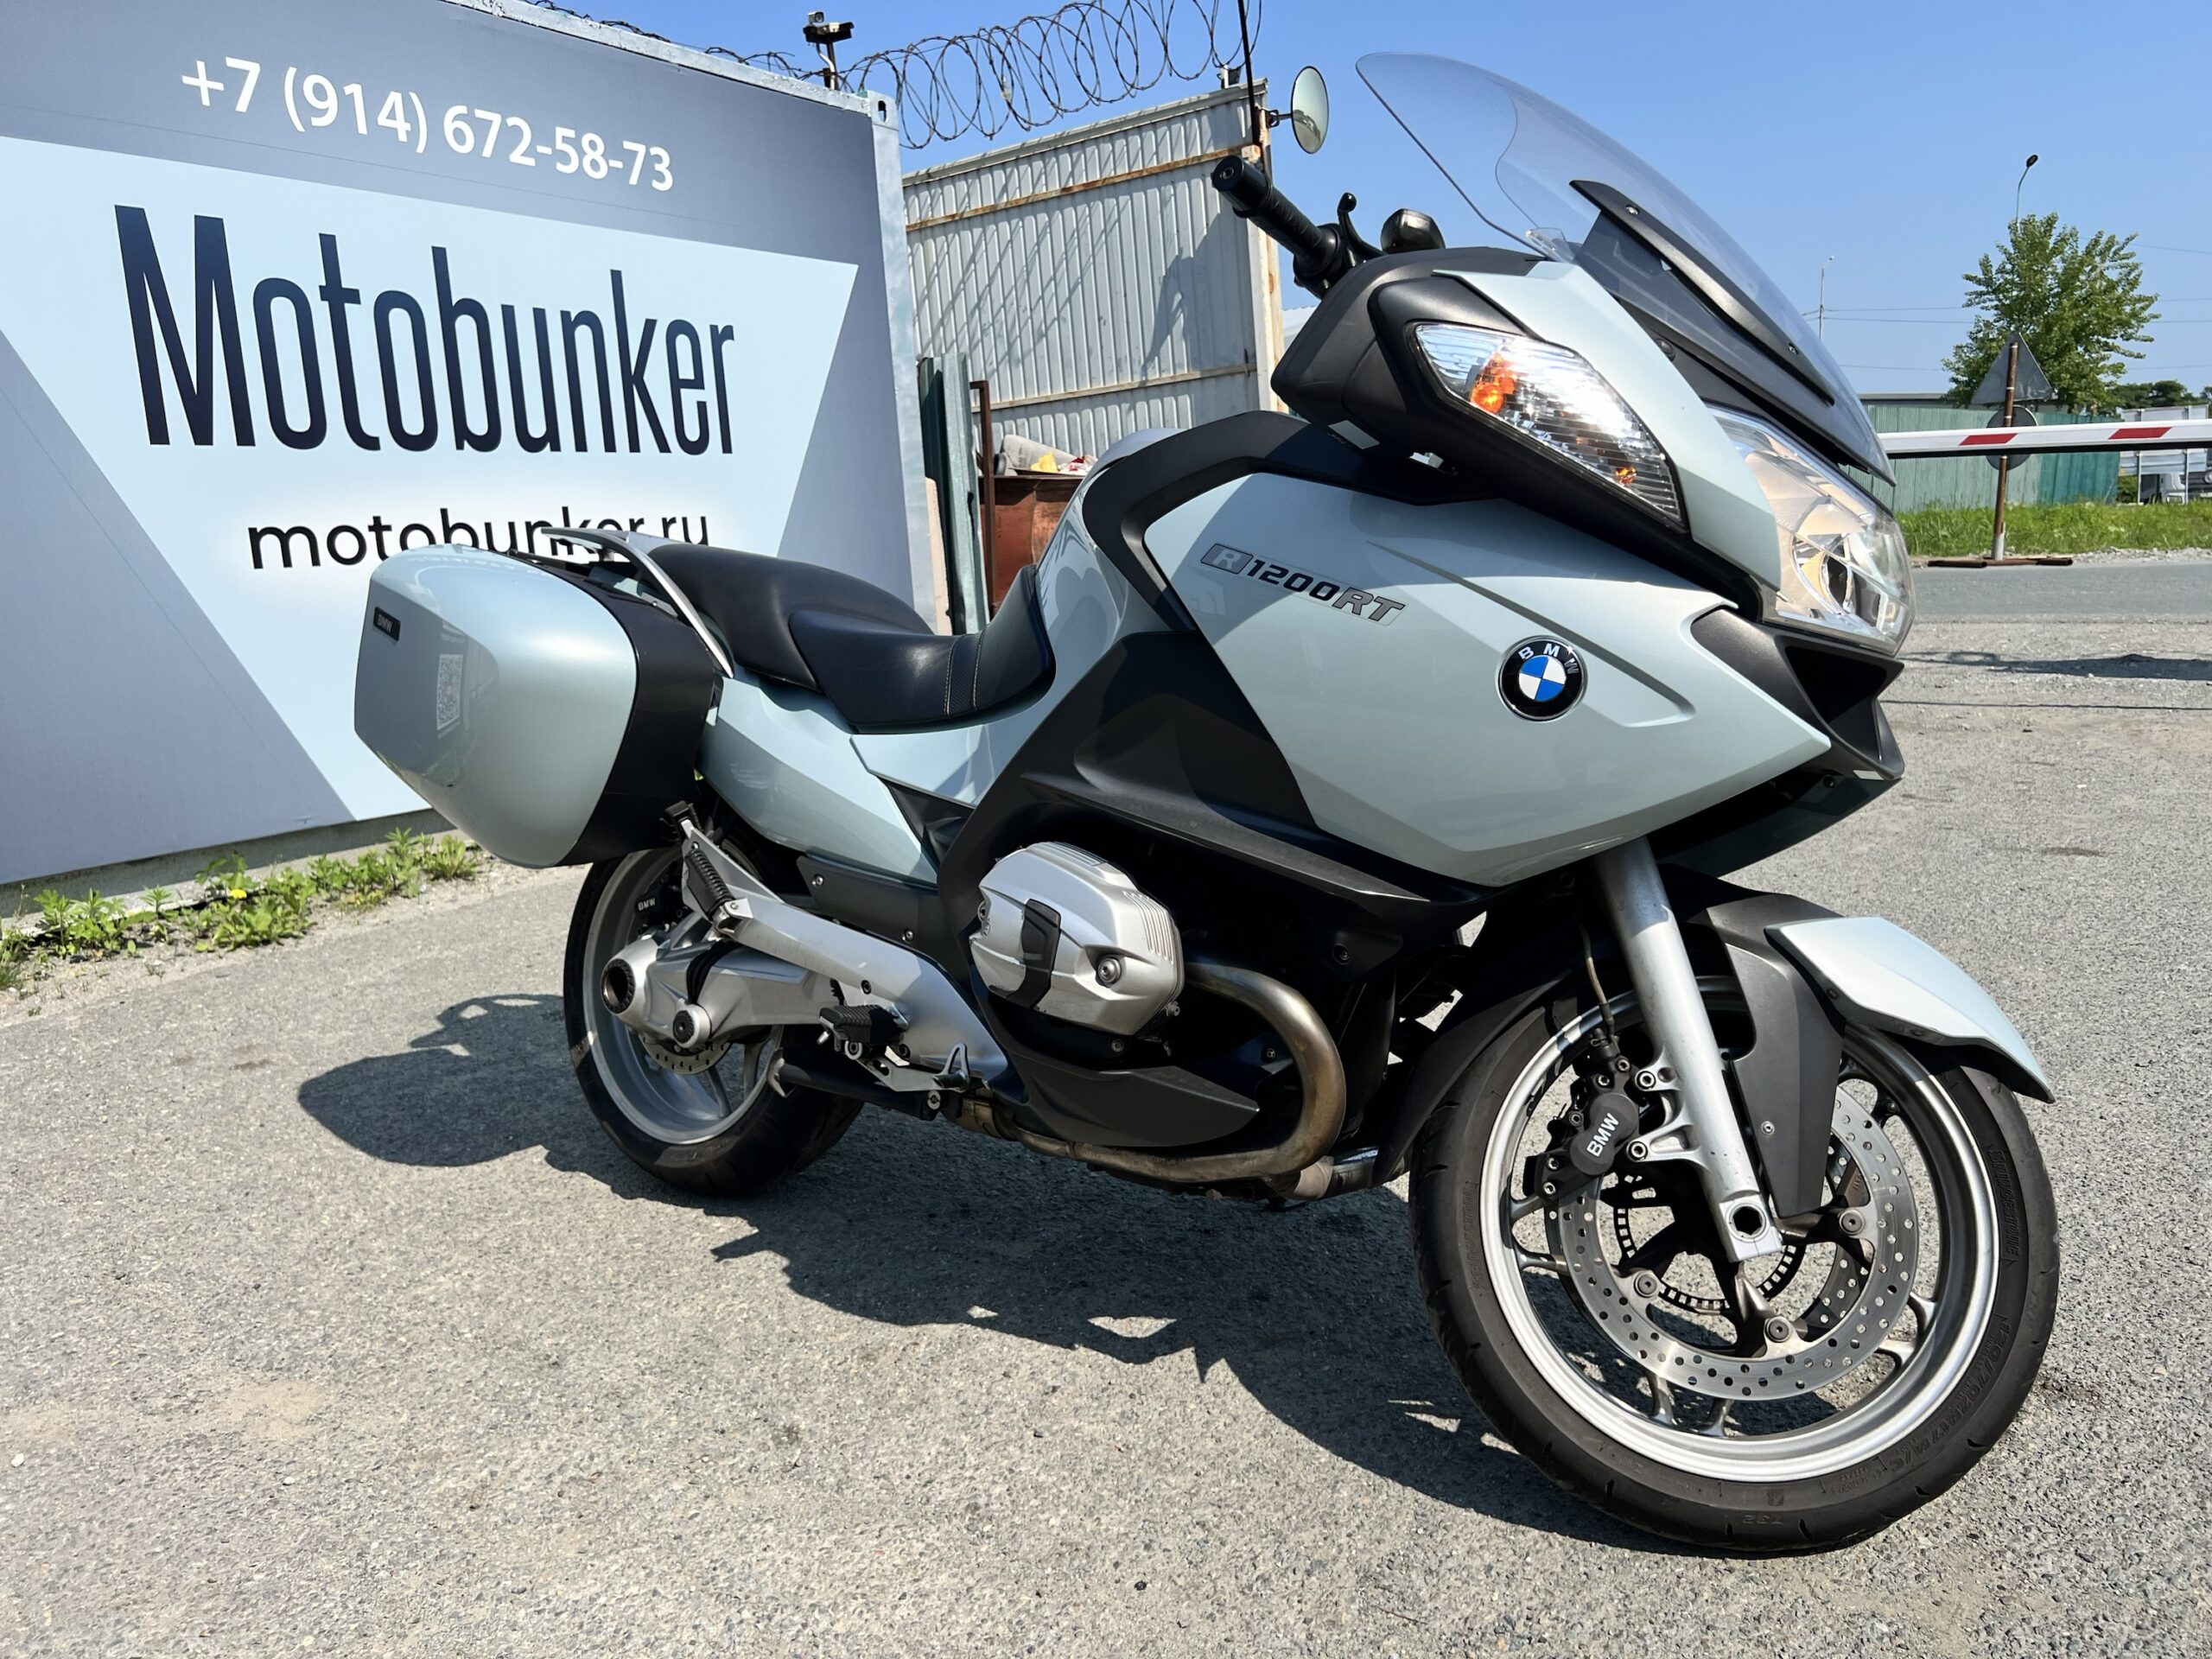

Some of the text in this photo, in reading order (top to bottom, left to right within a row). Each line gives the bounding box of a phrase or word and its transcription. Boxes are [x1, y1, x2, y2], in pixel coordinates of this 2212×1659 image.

[182, 57, 674, 192] +7 (914) 672-58-73
[114, 205, 734, 455] Motobunker
[1518, 643, 1580, 674] BMW
[638, 897, 656, 911] BMW
[1586, 1113, 1619, 1157] BMW
